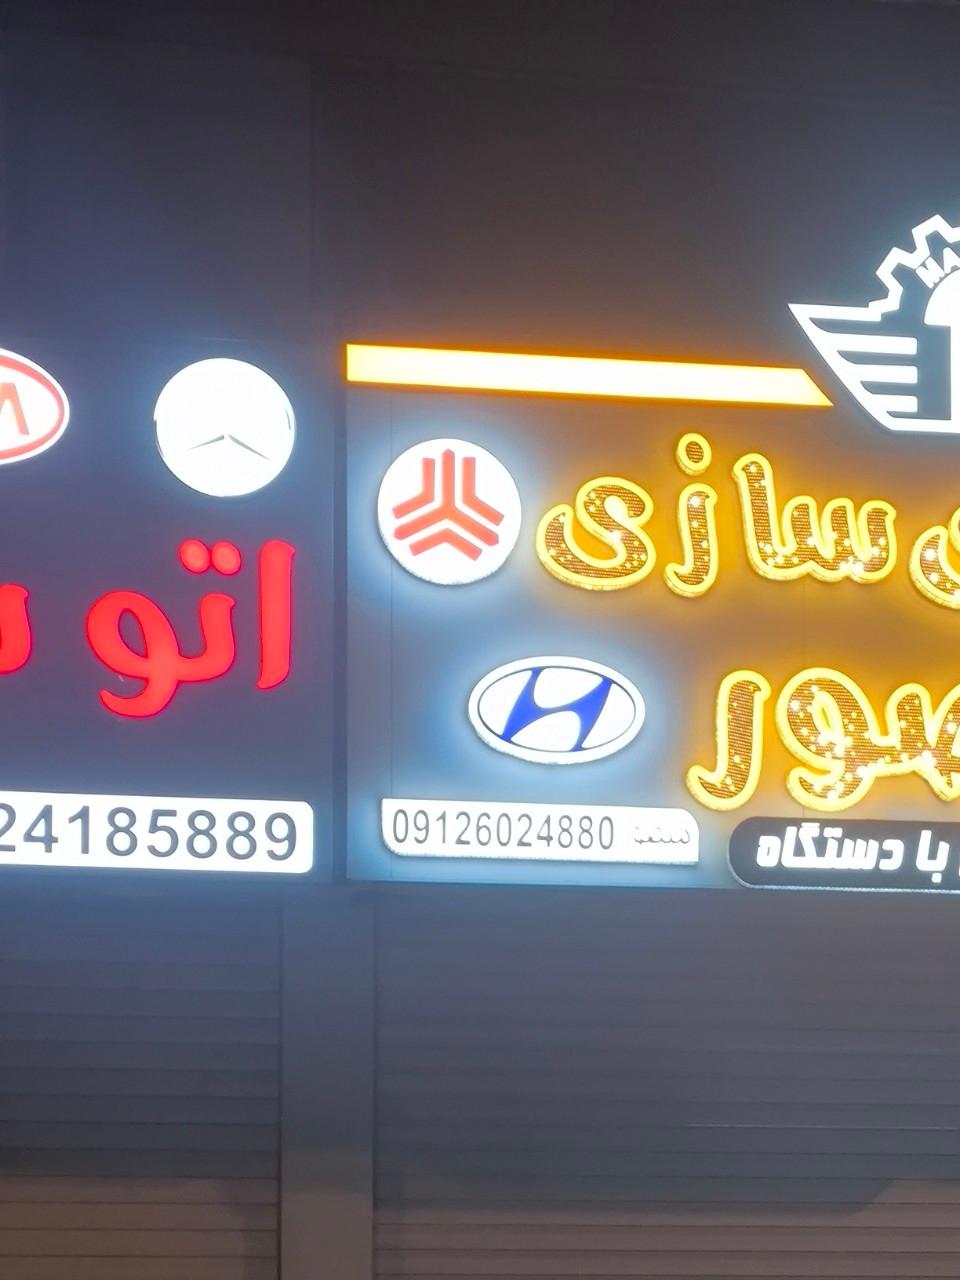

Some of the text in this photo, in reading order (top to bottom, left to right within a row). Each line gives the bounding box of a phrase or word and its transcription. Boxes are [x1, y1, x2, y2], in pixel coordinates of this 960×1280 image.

[86, 538, 296, 719] اتو
[0, 801, 299, 862] 24185889
[392, 807, 615, 851] 09126024880
[755, 822, 906, 871] دستگاه
[915, 828, 949, 883] با
